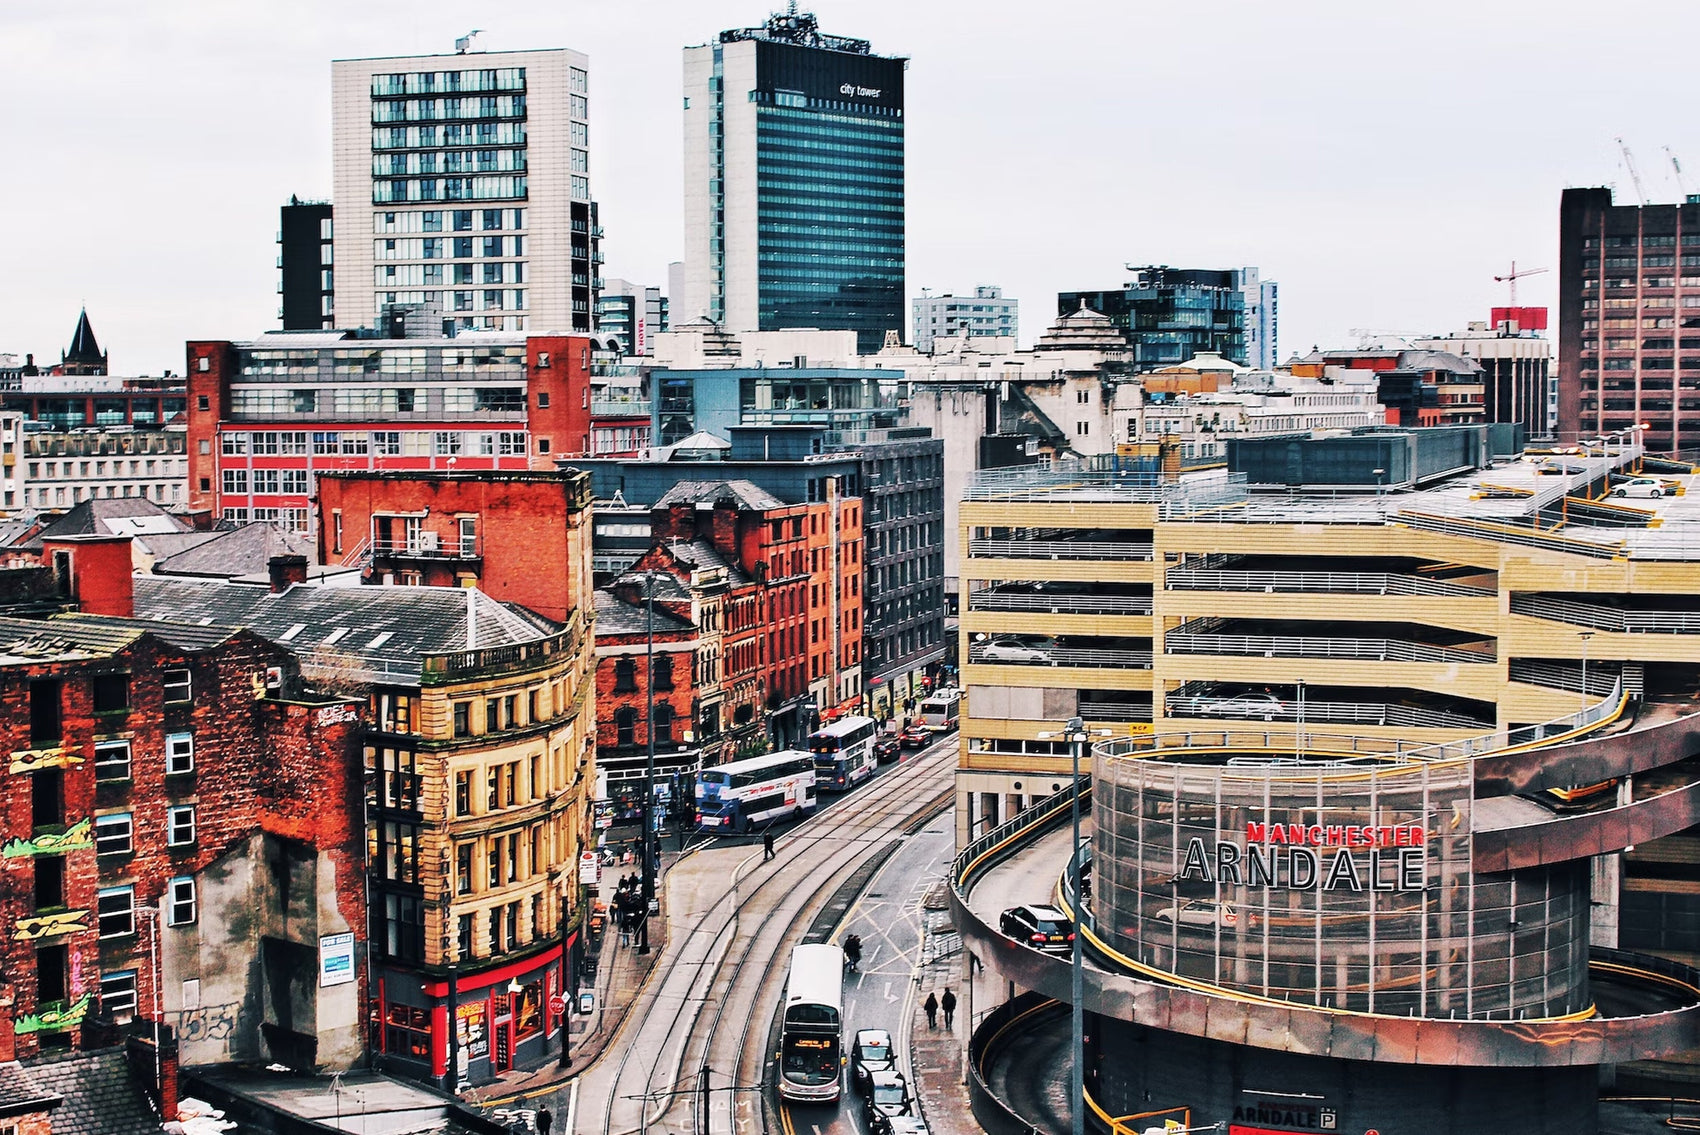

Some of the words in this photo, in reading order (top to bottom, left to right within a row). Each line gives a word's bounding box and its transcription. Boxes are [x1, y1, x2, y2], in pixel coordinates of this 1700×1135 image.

[840, 83, 855, 97] city
[857, 85, 881, 98] tower
[1247, 821, 1424, 847] MANCHESTER
[1180, 836, 1425, 892] ARNDALE
[1233, 1105, 1316, 1129] ARNDALE
